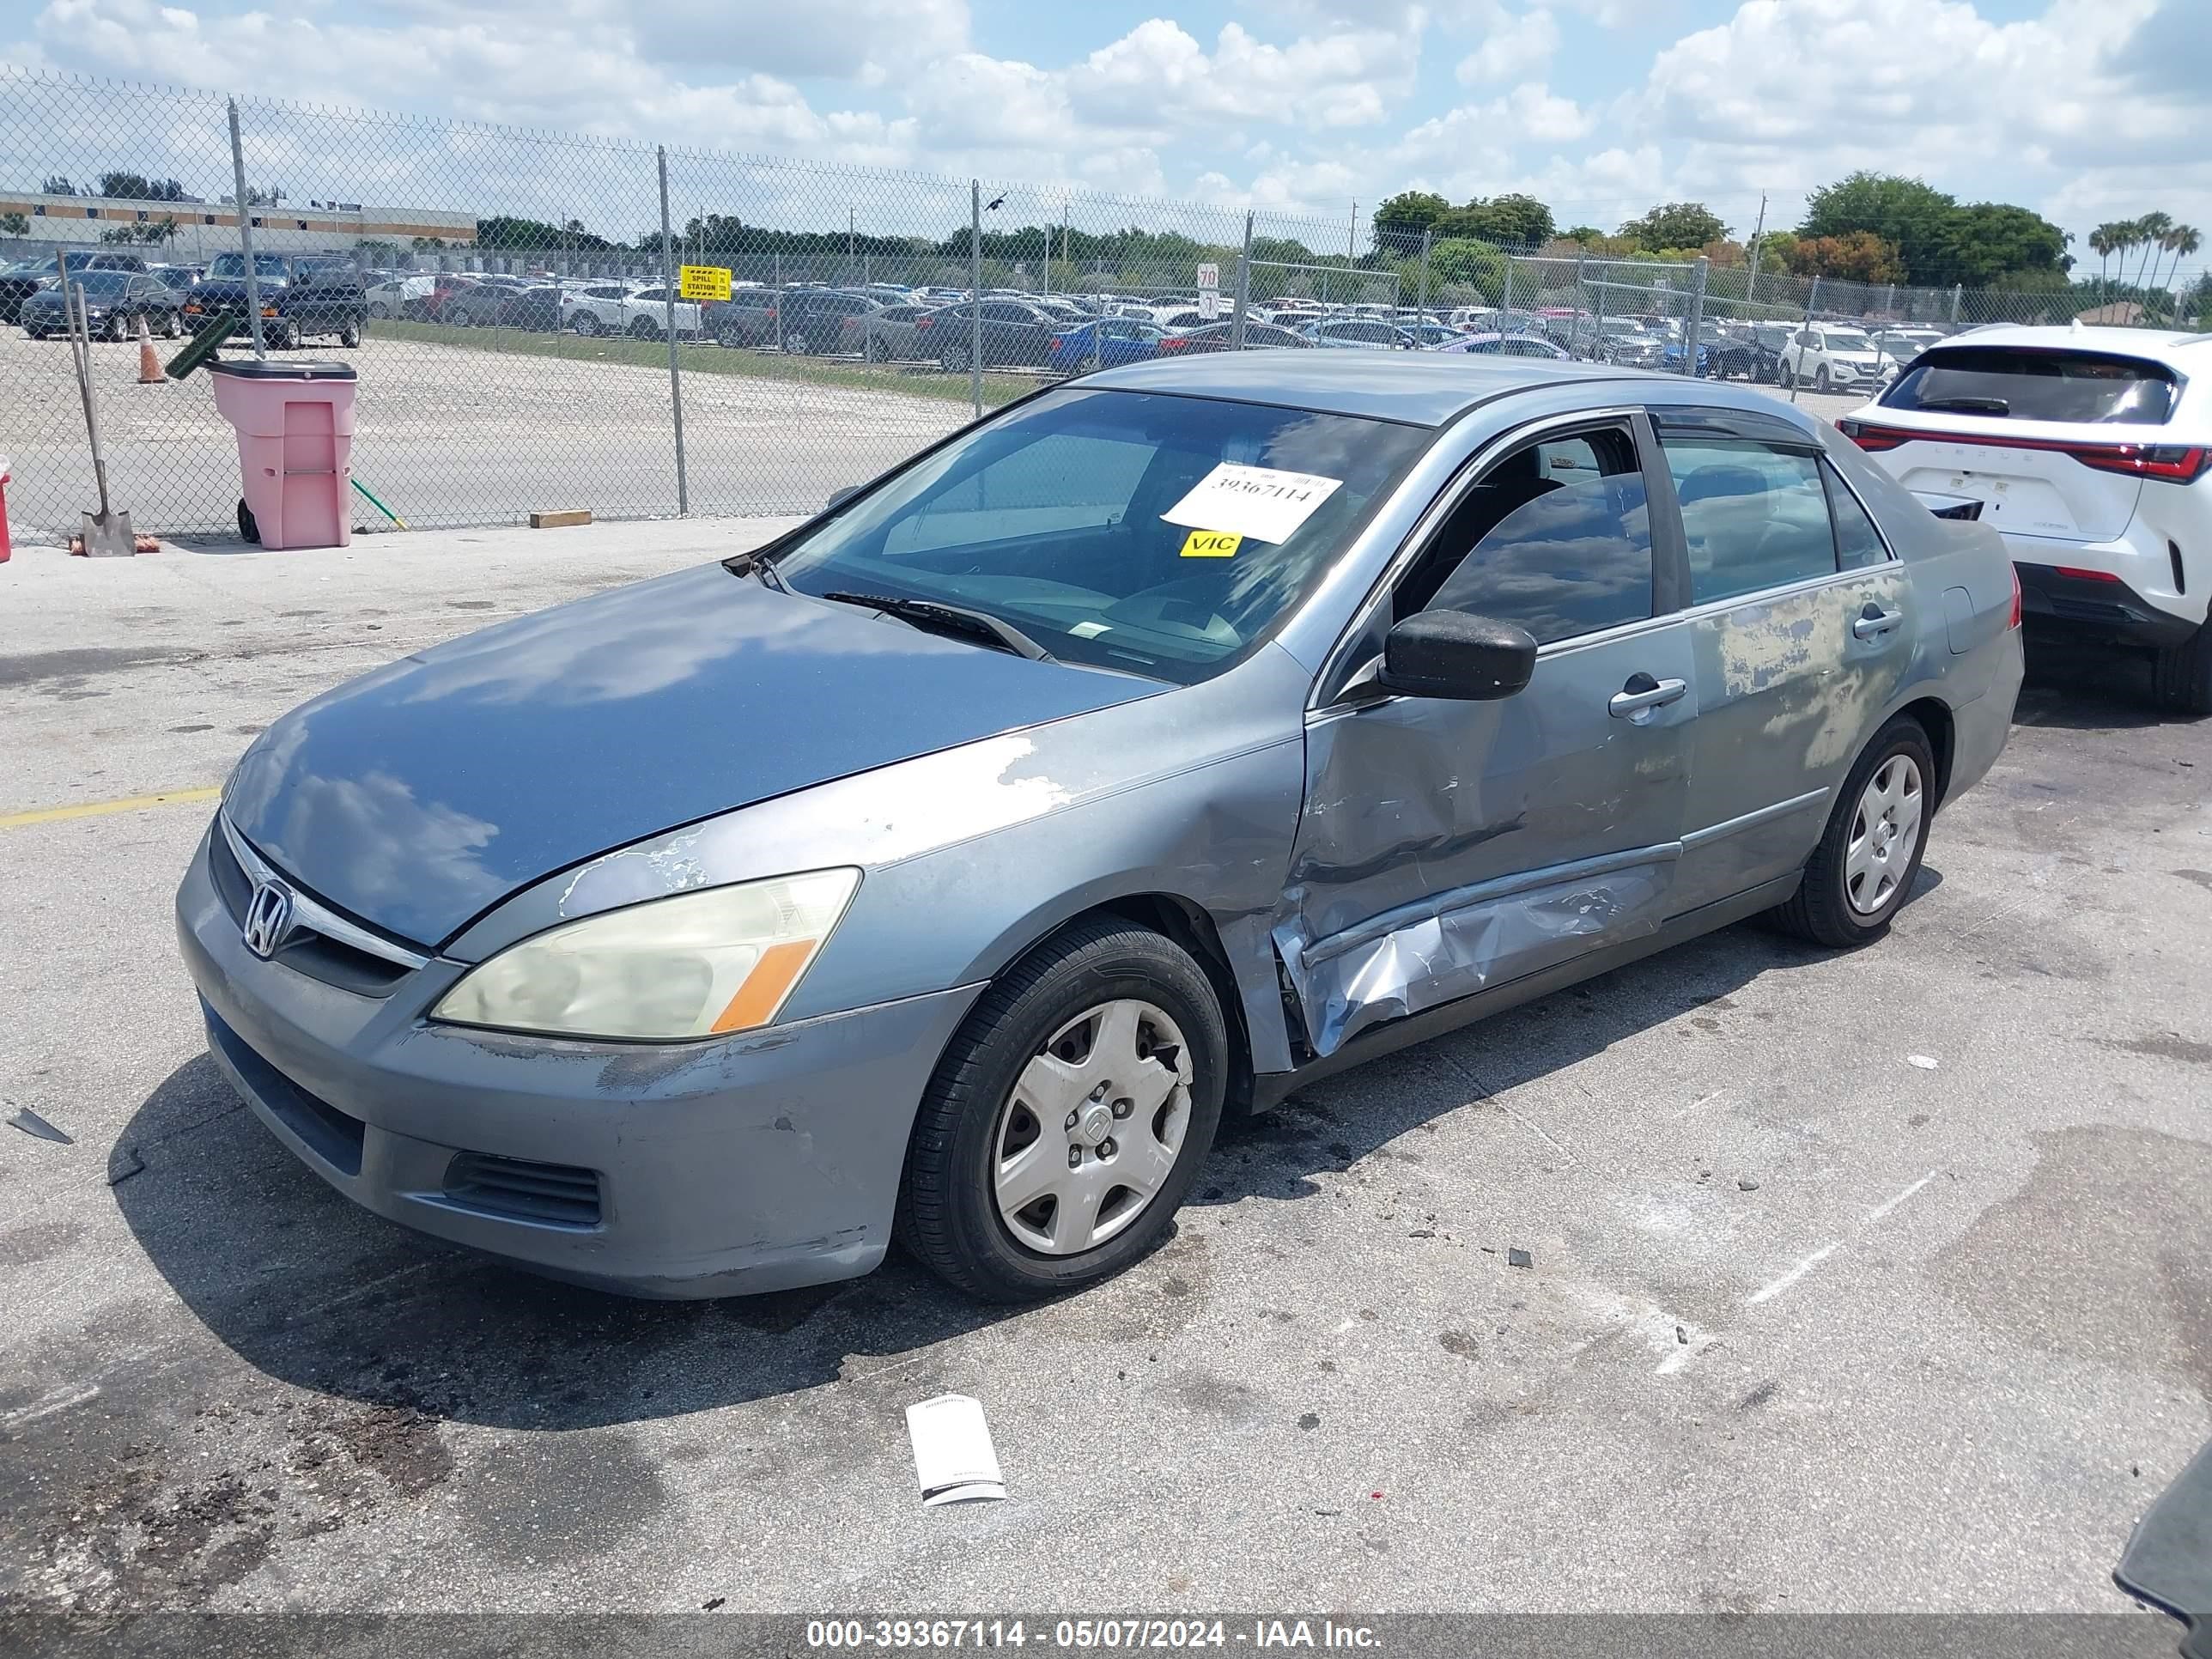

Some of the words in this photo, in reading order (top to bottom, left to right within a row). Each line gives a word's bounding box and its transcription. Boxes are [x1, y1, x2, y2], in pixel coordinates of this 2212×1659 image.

[1200, 270, 1216, 285] 70
[687, 283, 716, 291] STATION
[1212, 478, 1312, 502] 39367114
[1192, 537, 1236, 550] VIC
